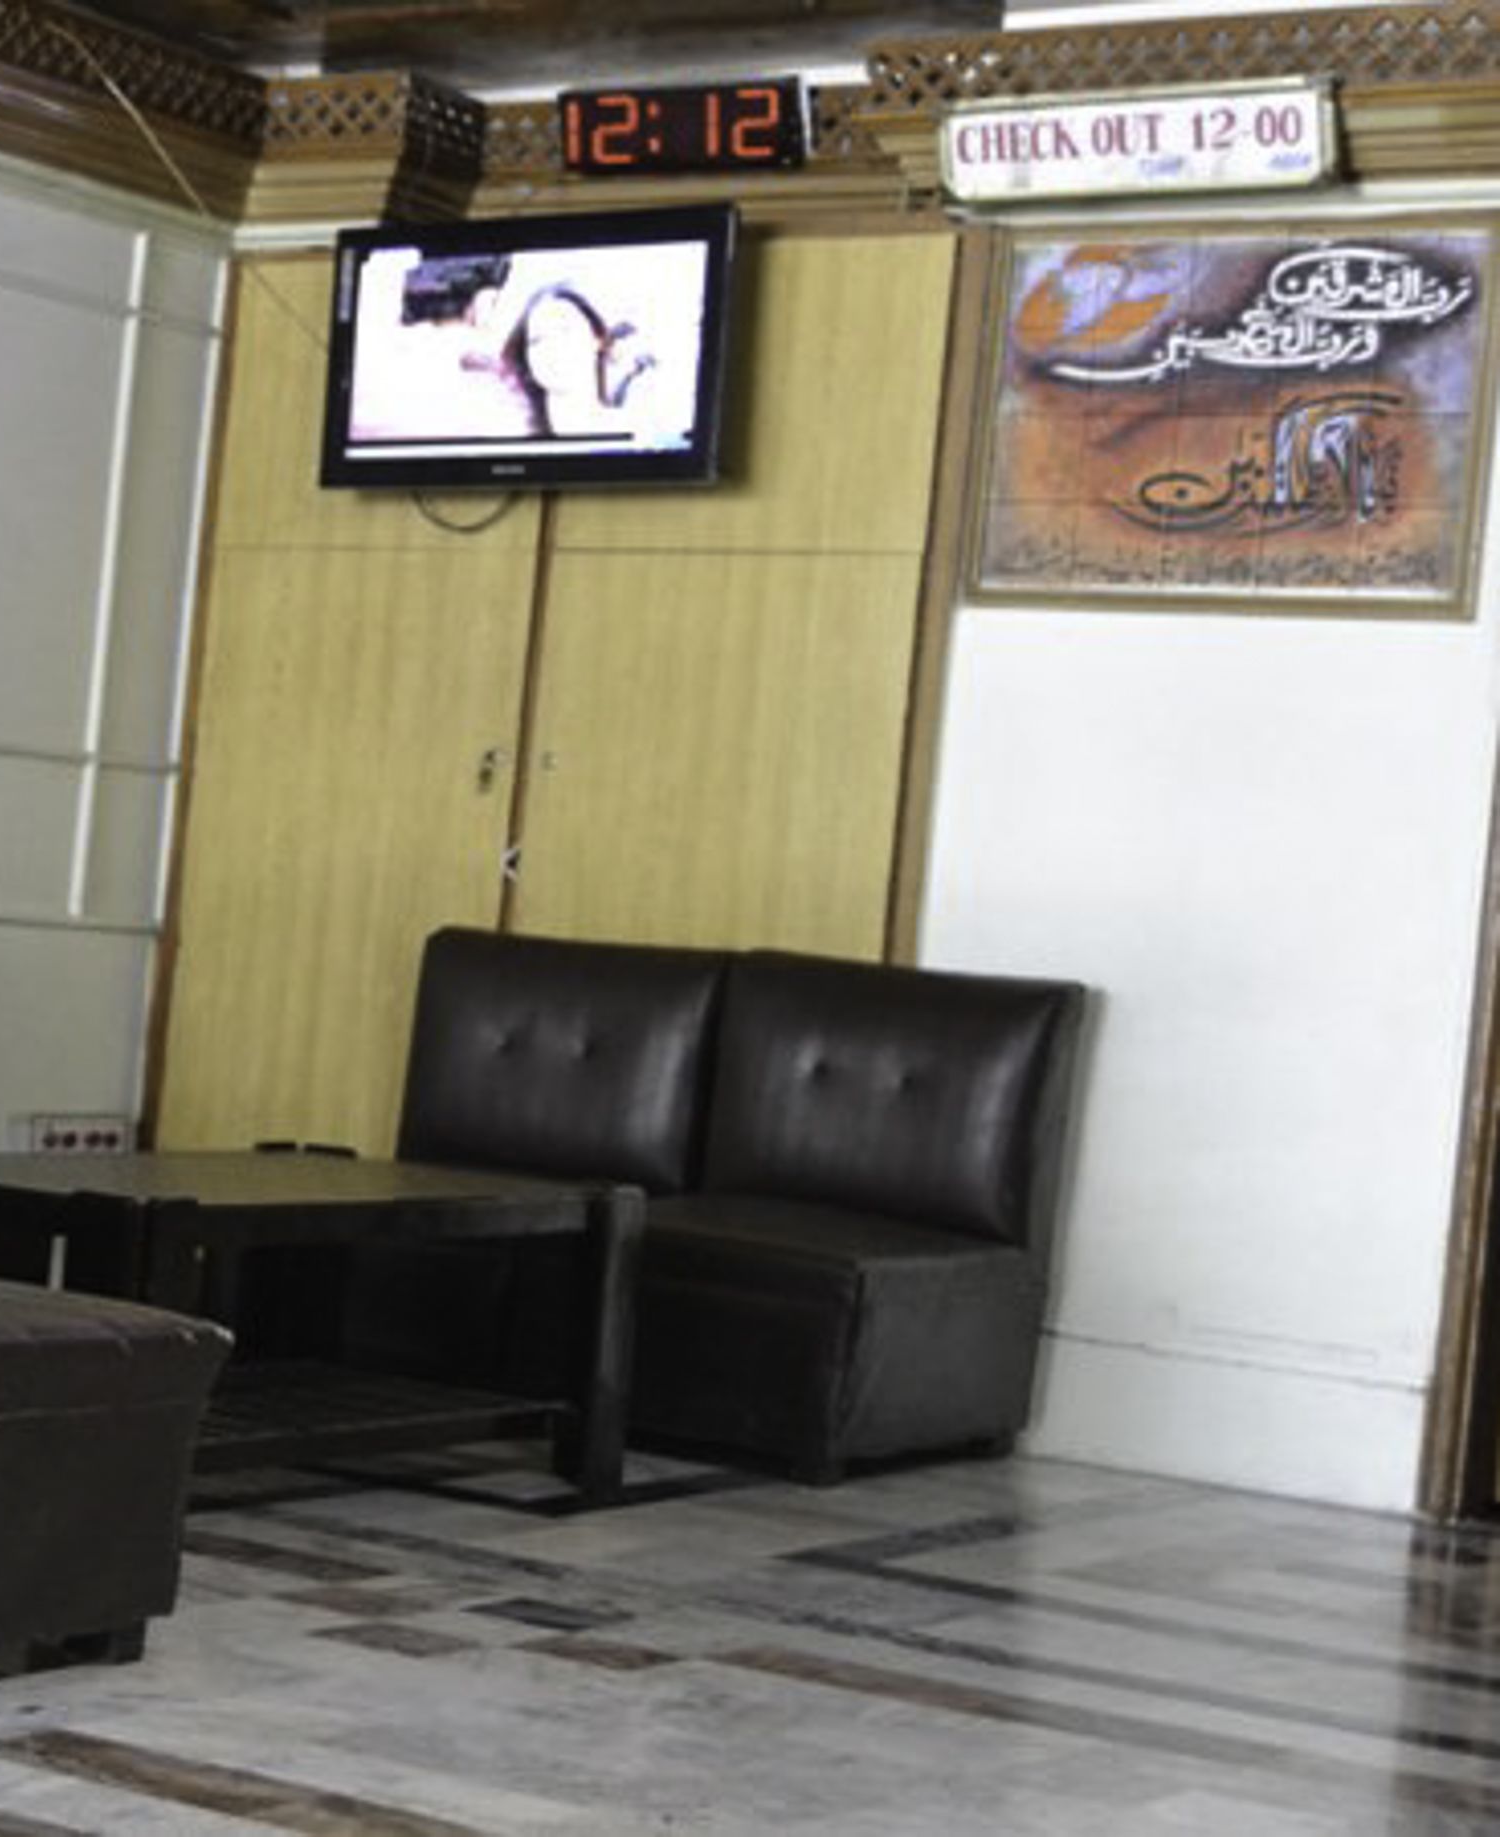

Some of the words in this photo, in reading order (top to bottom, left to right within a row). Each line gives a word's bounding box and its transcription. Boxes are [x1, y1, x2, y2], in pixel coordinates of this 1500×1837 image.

[566, 89, 779, 165] 12:12
[956, 117, 1080, 164] CHECK
[1091, 111, 1163, 156] OUT
